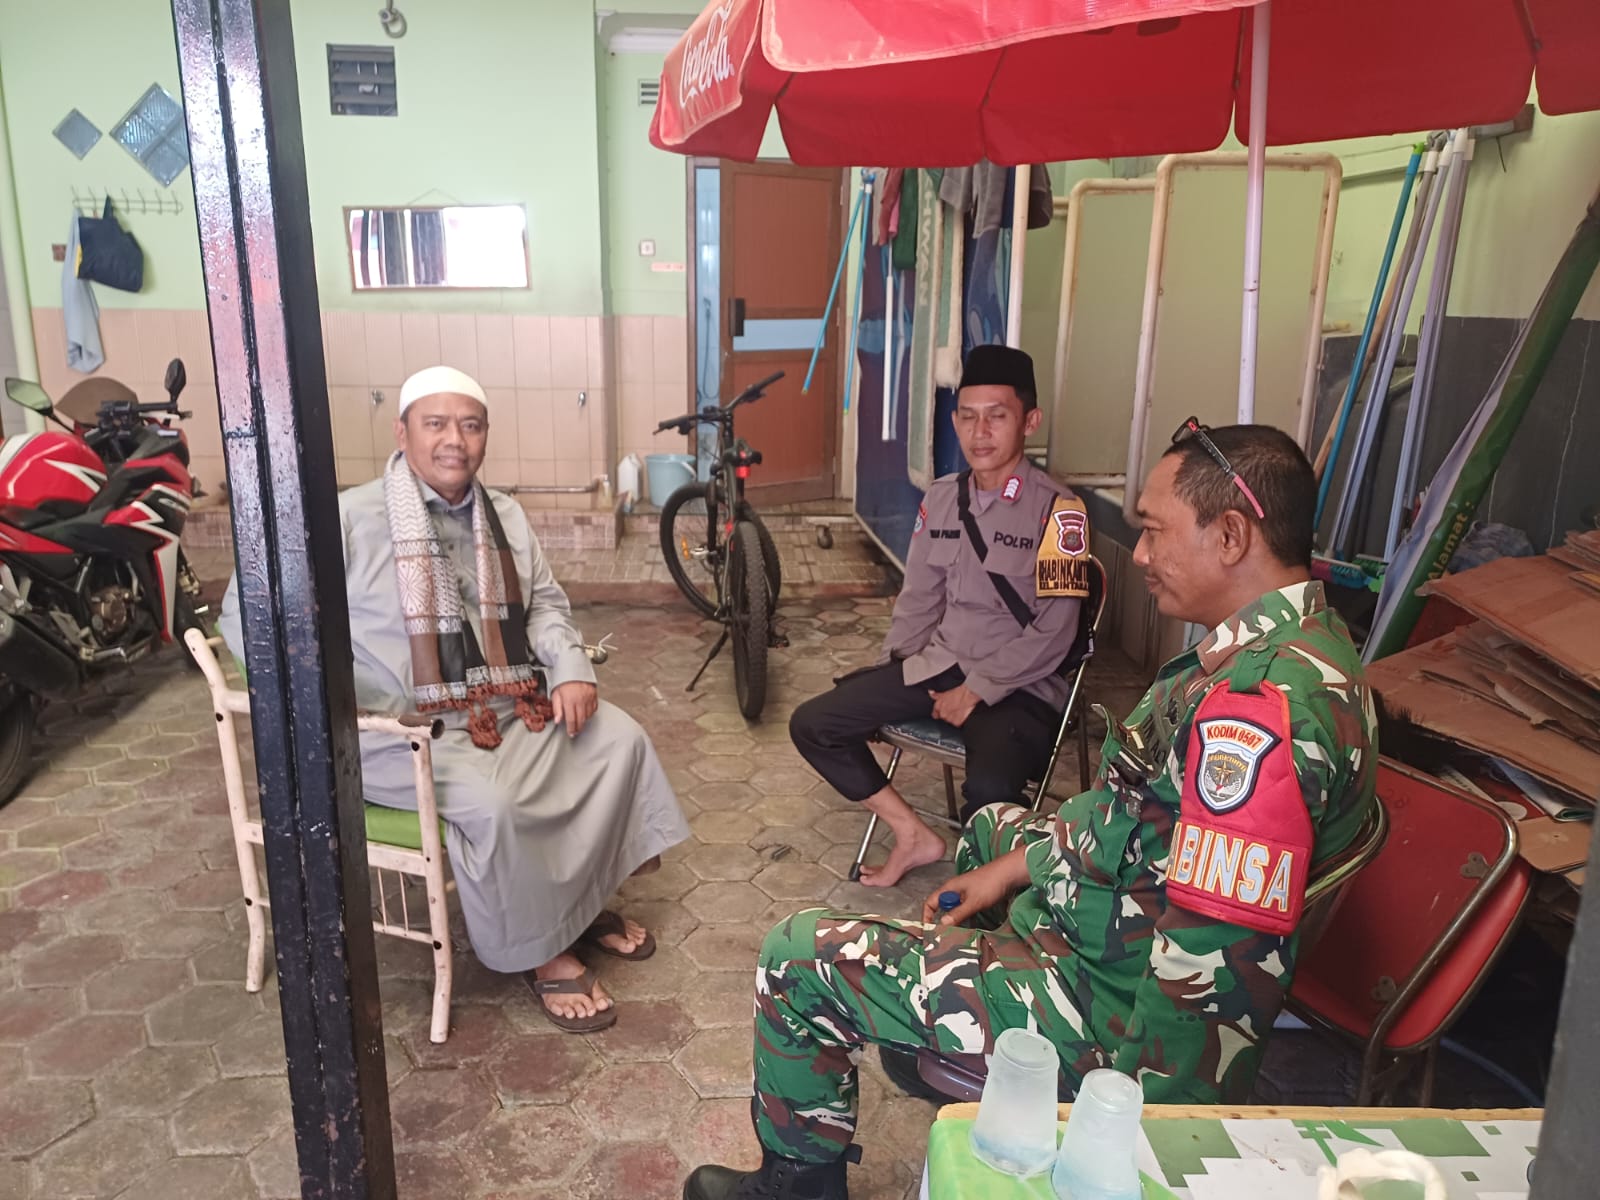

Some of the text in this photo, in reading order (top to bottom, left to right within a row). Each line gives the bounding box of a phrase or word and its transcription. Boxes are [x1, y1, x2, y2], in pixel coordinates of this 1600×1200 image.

[994, 531, 1034, 549] POLRI
[1206, 725, 1262, 748] KODIM 0507
